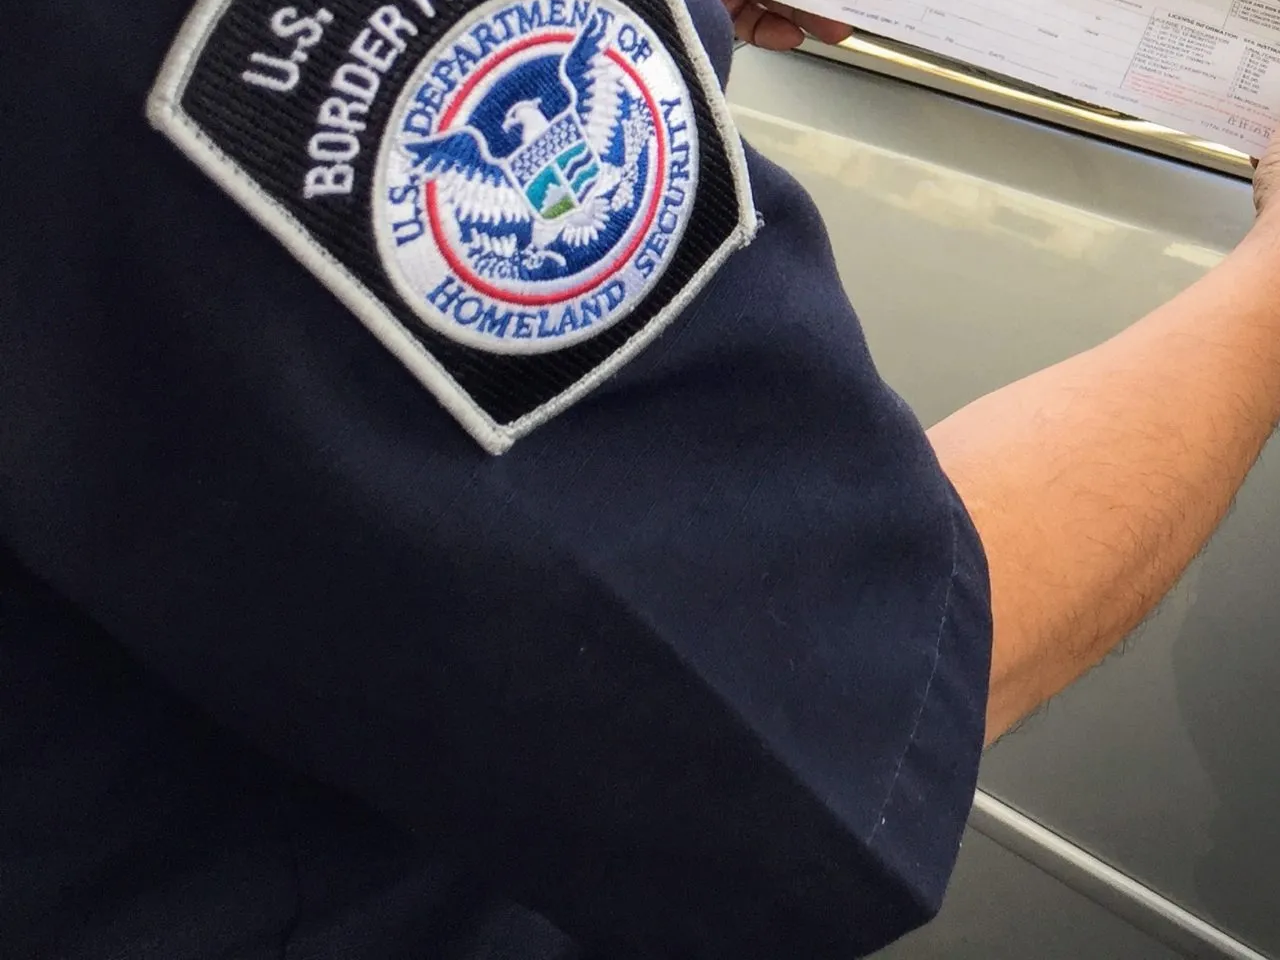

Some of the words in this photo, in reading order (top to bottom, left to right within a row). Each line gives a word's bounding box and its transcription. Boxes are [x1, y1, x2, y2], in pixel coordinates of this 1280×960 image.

[243, 6, 334, 91] U.S.
[304, 4, 418, 199] BORDER
[389, 174, 425, 248] U.S.
[617, 23, 654, 63] OF
[426, 276, 628, 339] HOMELAND
[634, 96, 691, 279] SECURITY
